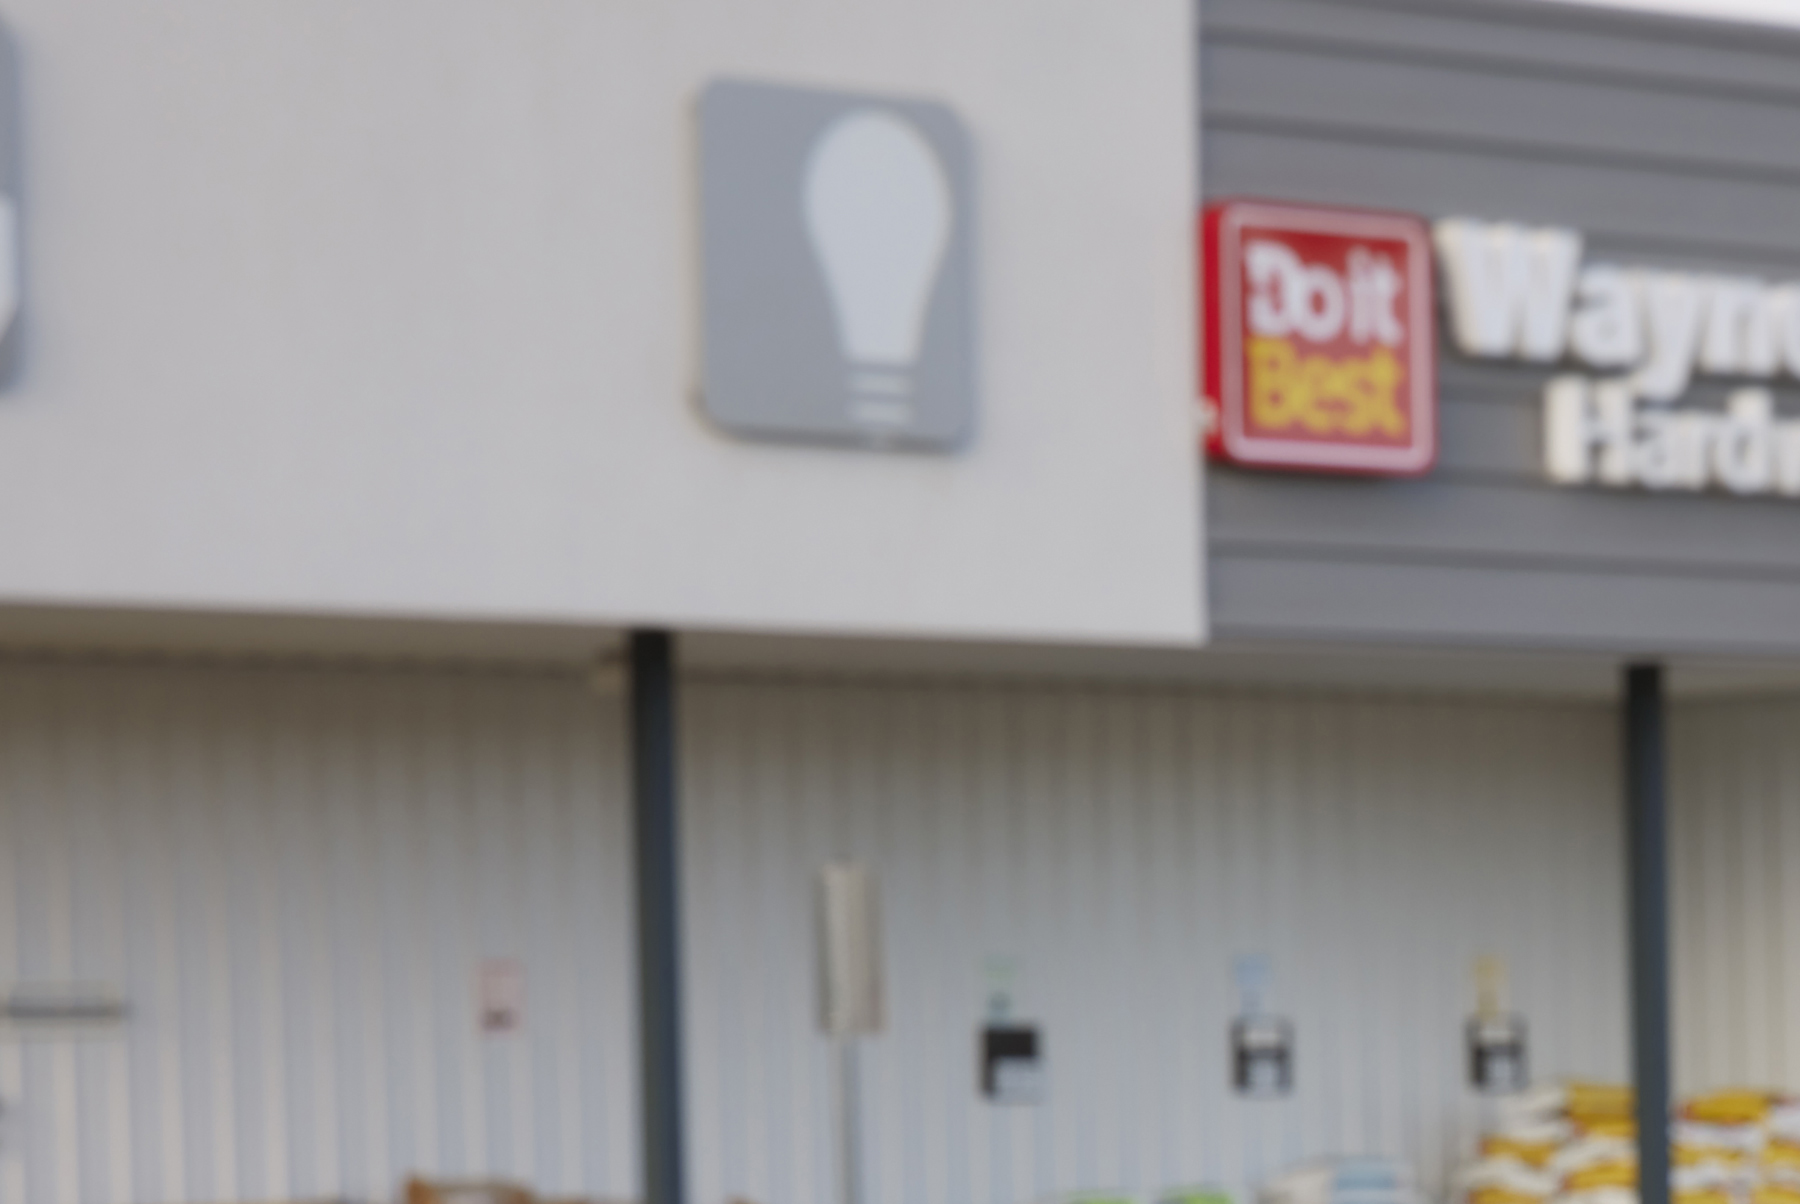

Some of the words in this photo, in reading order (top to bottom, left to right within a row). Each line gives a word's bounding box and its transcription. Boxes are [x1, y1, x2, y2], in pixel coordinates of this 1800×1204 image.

[1244, 238, 1346, 340] Do
[1349, 246, 1406, 347] it
[1246, 334, 1406, 435] Best
